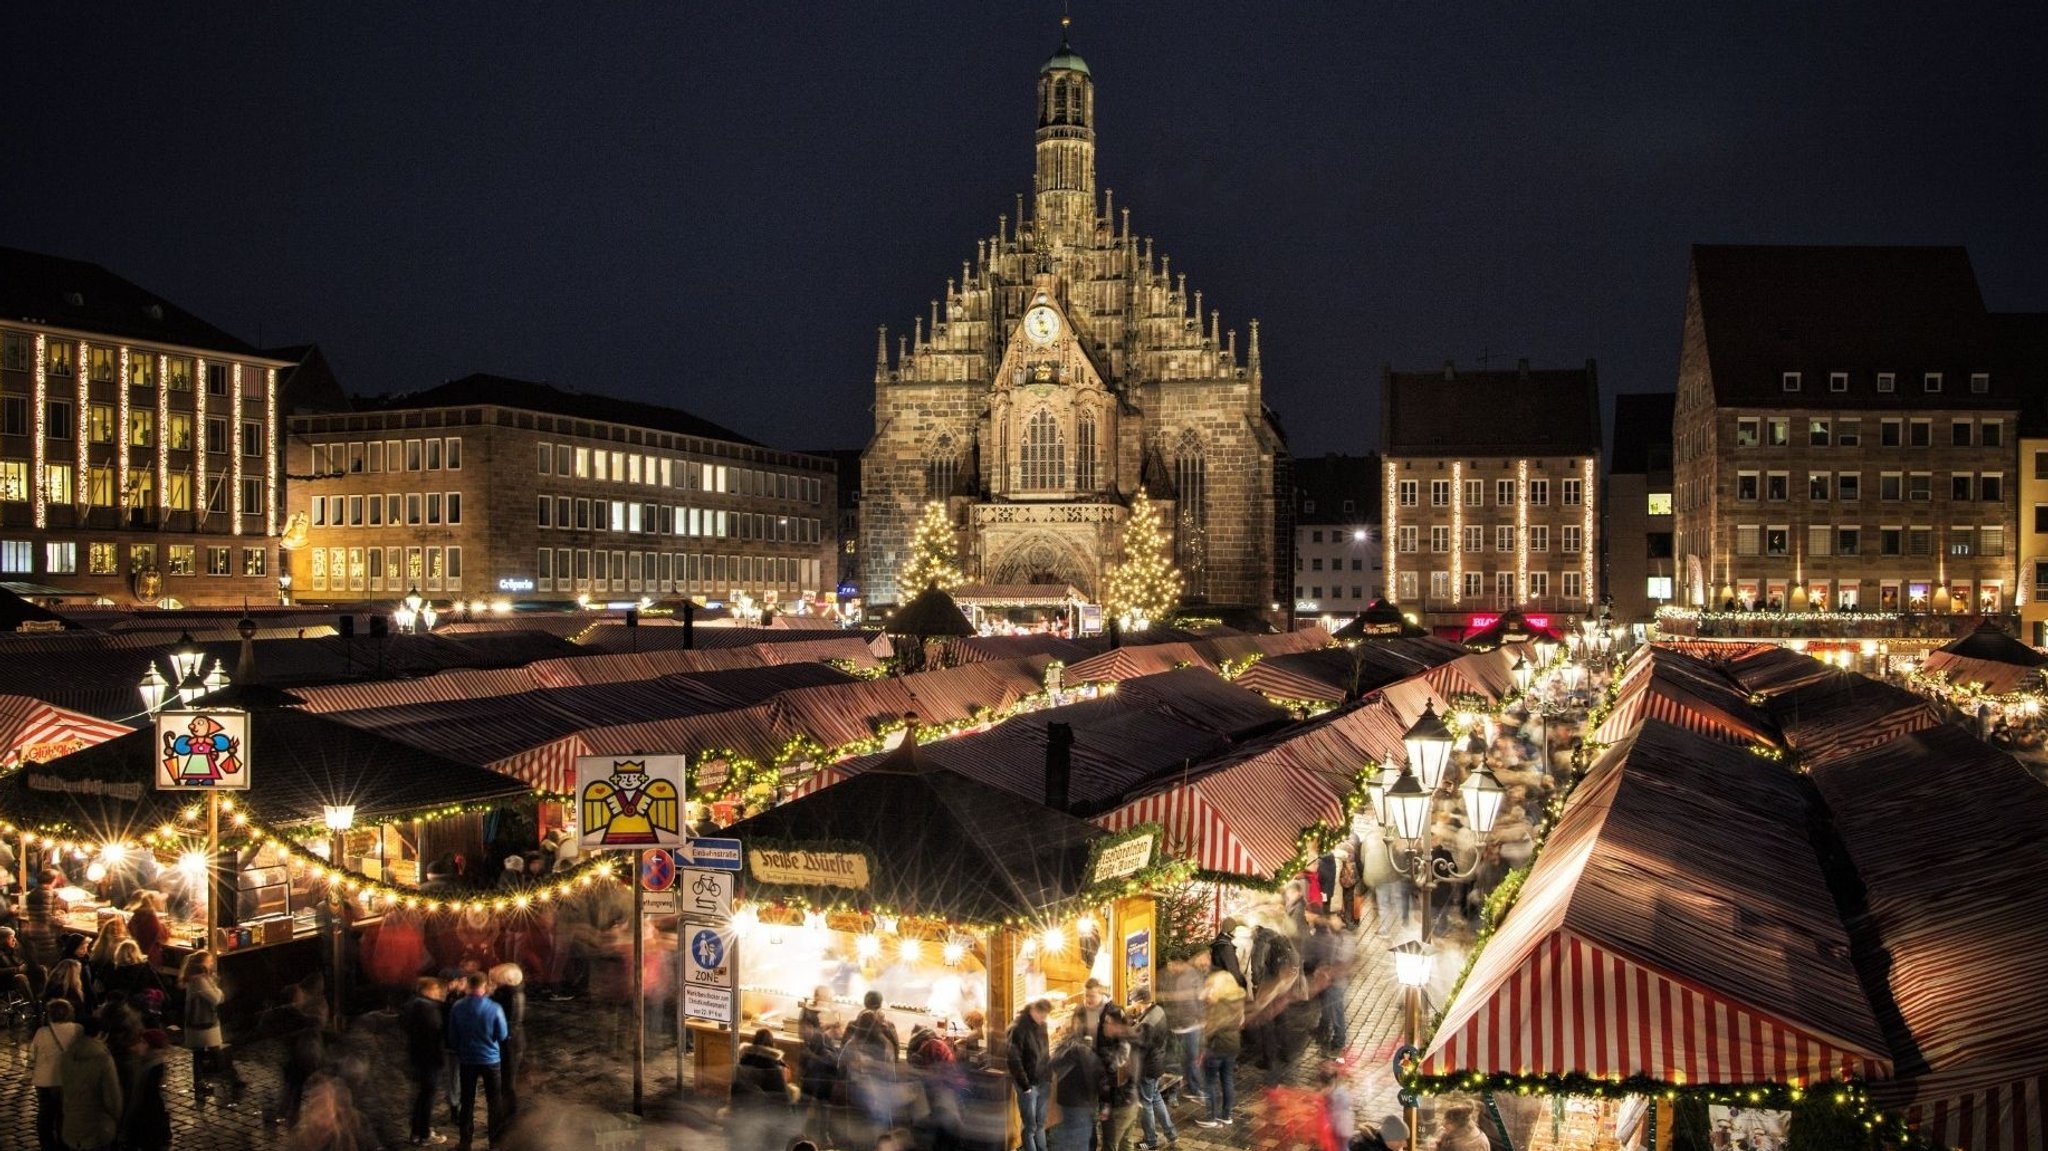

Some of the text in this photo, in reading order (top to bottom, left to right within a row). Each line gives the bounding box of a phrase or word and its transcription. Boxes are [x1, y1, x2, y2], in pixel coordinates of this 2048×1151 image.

[692, 848, 737, 858] Einbahnstraße
[695, 970, 719, 983] ZONE
[1401, 1094, 1413, 1103] WC
